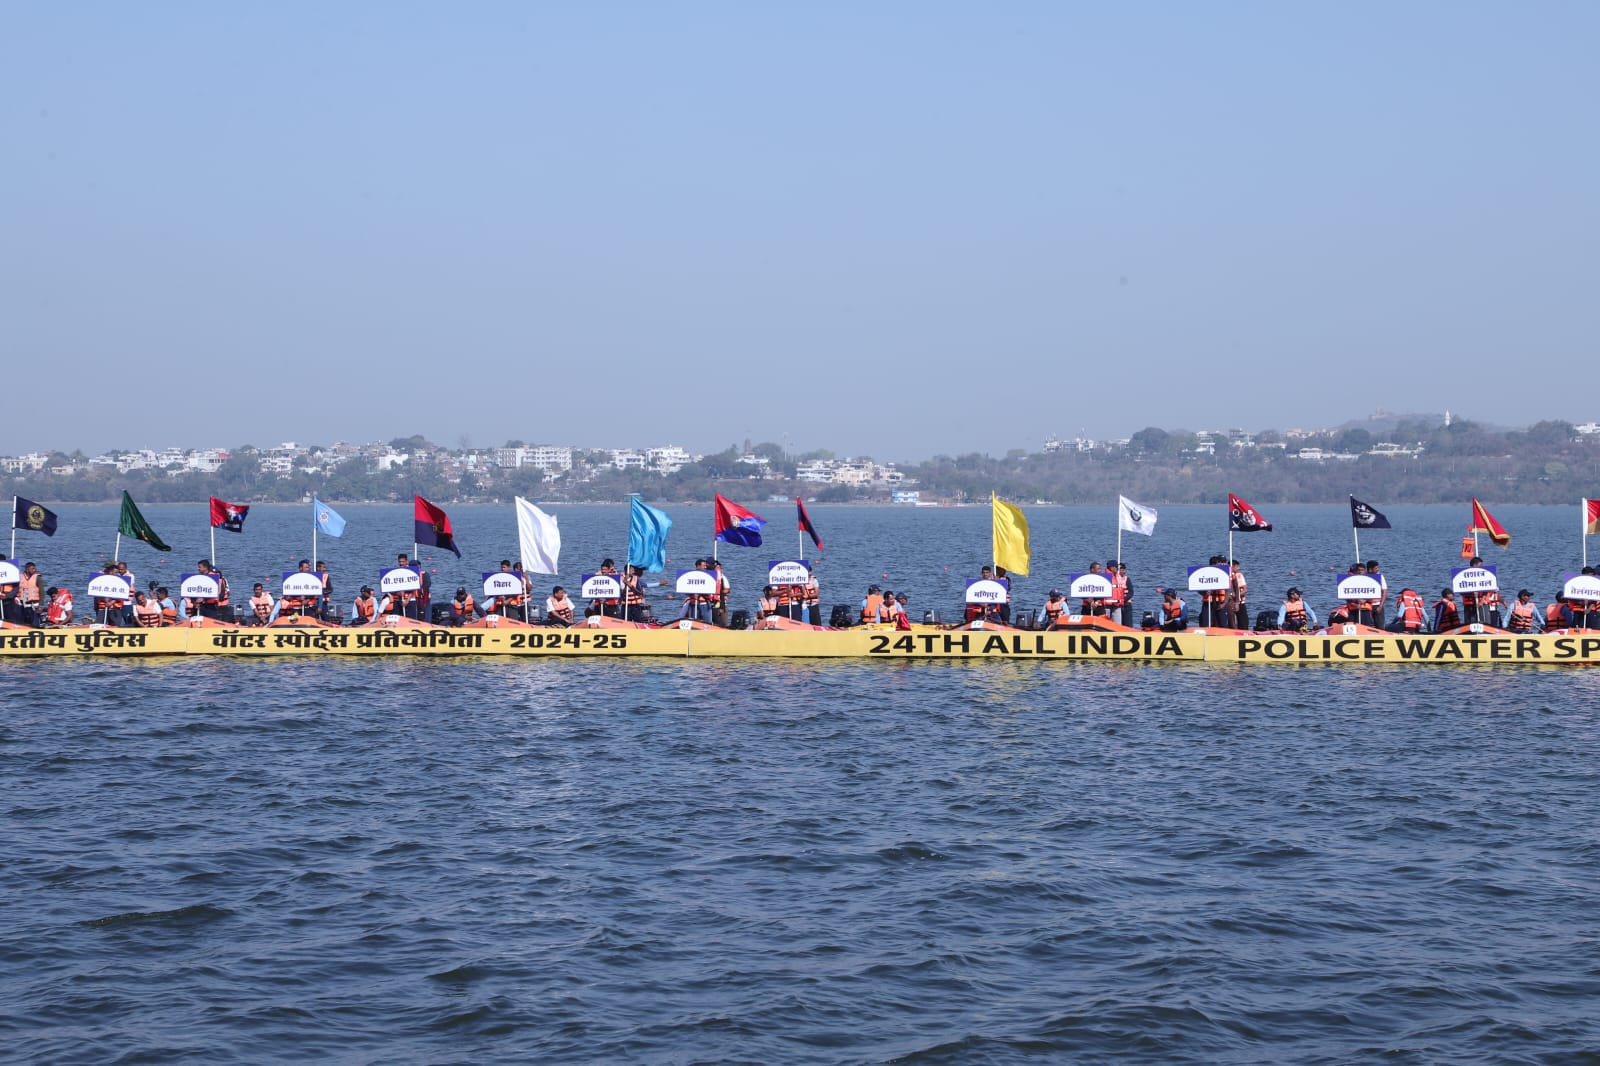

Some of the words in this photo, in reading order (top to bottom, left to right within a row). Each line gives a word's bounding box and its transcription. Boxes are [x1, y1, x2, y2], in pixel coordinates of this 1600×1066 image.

[493, 580, 512, 588] बिहार
[974, 590, 998, 600] मणिपुर
[75, 630, 148, 652] पुलिस
[212, 630, 267, 648] वॉटर
[356, 629, 485, 648] प्रतियोगिता
[510, 634, 627, 648] 2024-25
[869, 635, 969, 653] 24TH
[982, 635, 1056, 654] ALL
[1068, 636, 1183, 655] INDIA
[1238, 639, 1385, 659] POLICE
[1395, 639, 1541, 658] WATER
